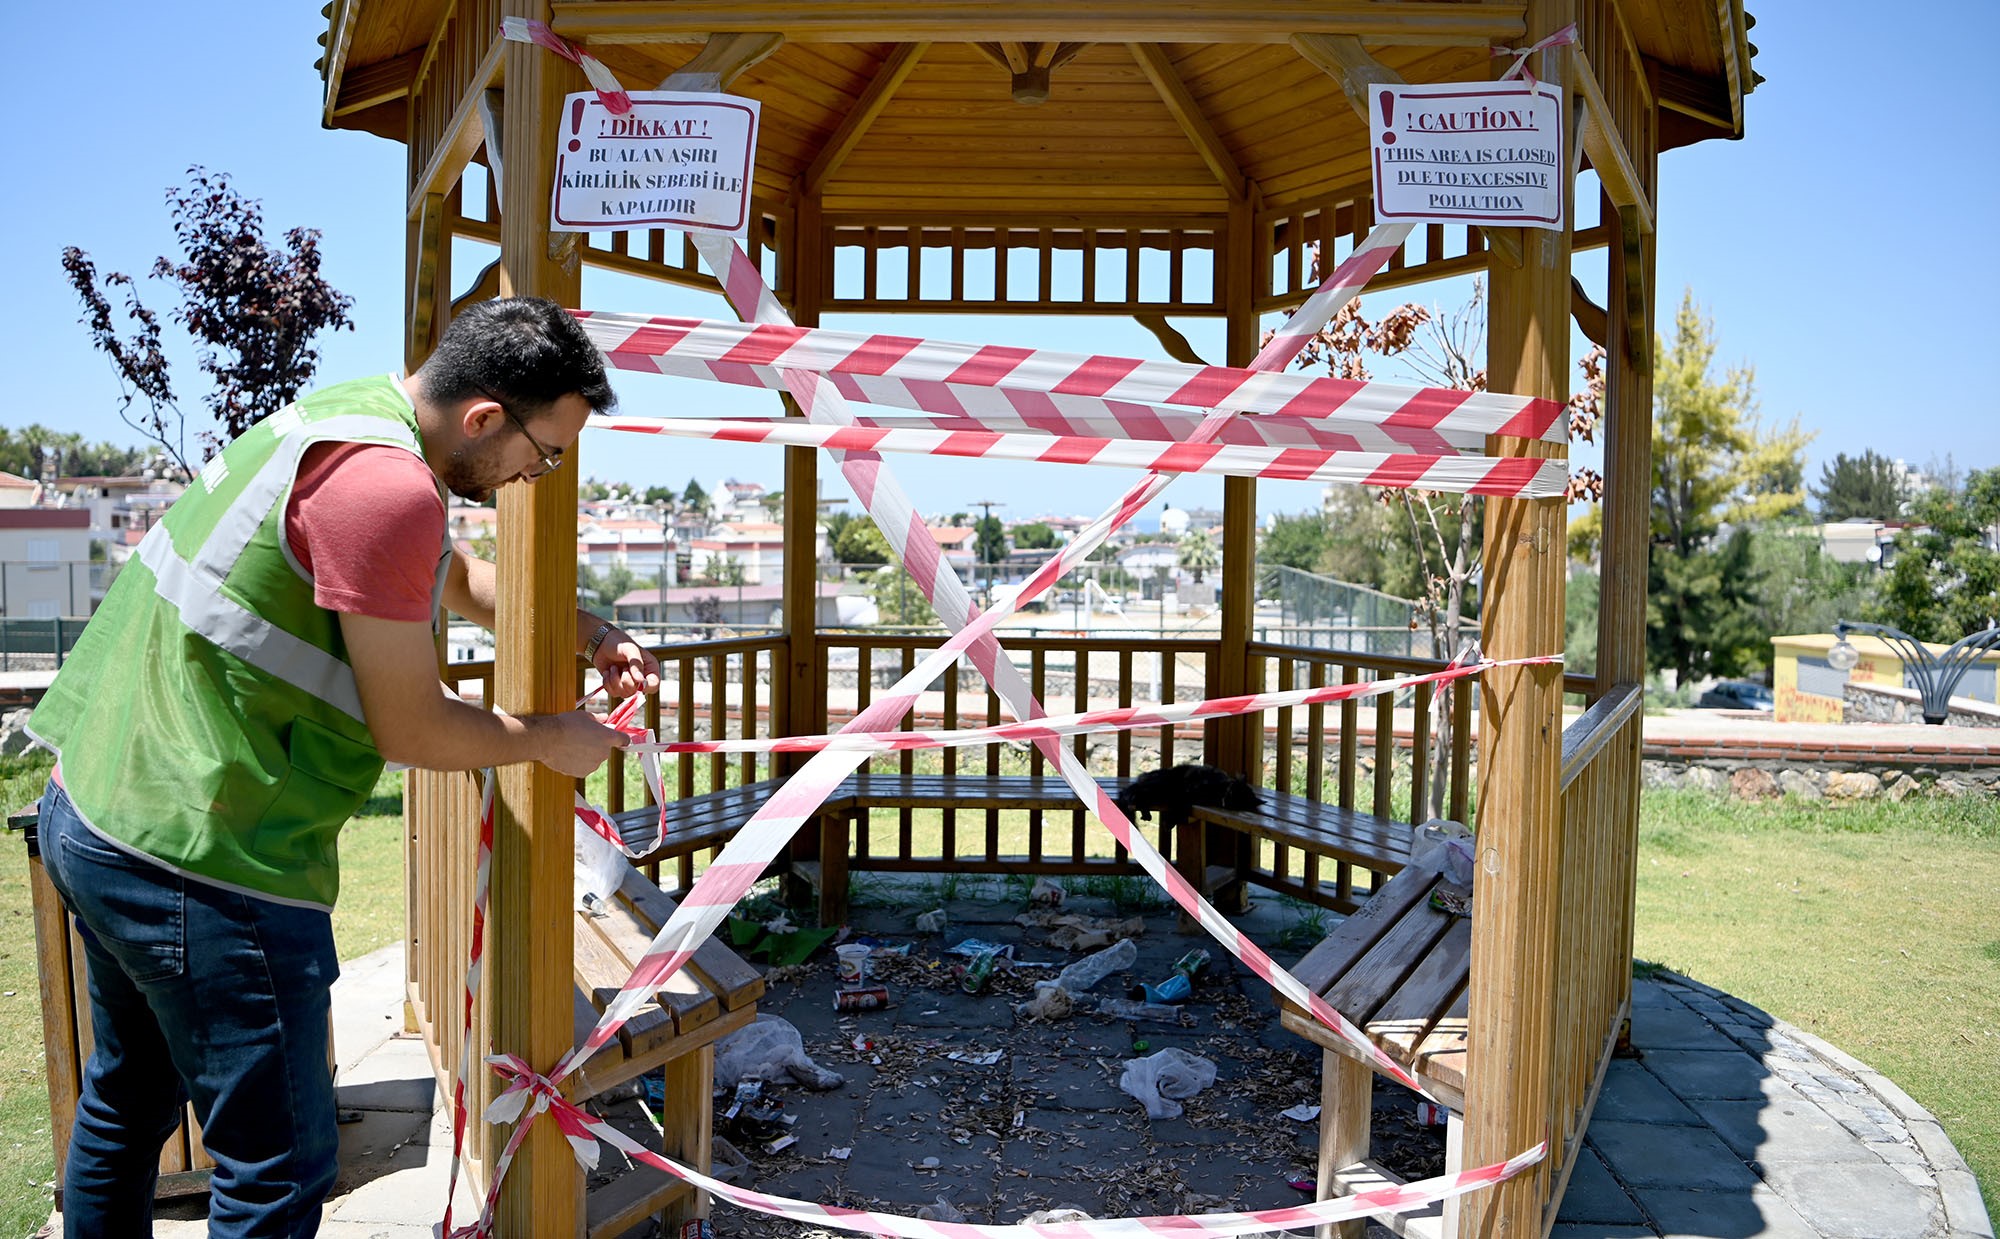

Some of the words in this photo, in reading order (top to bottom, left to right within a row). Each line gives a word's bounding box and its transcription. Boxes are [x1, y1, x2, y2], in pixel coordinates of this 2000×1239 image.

[600, 120, 606, 135] !
[611, 114, 697, 136] DİKKAT
[702, 120, 708, 135] !
[1407, 113, 1412, 129] !
[1529, 111, 1534, 127] !
[589, 148, 613, 162] BU
[616, 149, 665, 163] ALAN
[668, 149, 718, 166] AŞIRI
[1385, 148, 1425, 161] THIS
[1428, 149, 1472, 163] AREA
[1477, 149, 1492, 162] IS
[1496, 148, 1555, 164] CLOSED
[562, 170, 642, 189] KİRLİLİK
[645, 170, 709, 190] SEBEBİ
[712, 171, 743, 193] İLE
[1398, 170, 1432, 184] DUE
[1435, 171, 1457, 184] TO
[1461, 172, 1548, 187] EXCESSIVE
[601, 199, 696, 215] KAPALIDIR
[1429, 194, 1524, 208] POLLUTION
